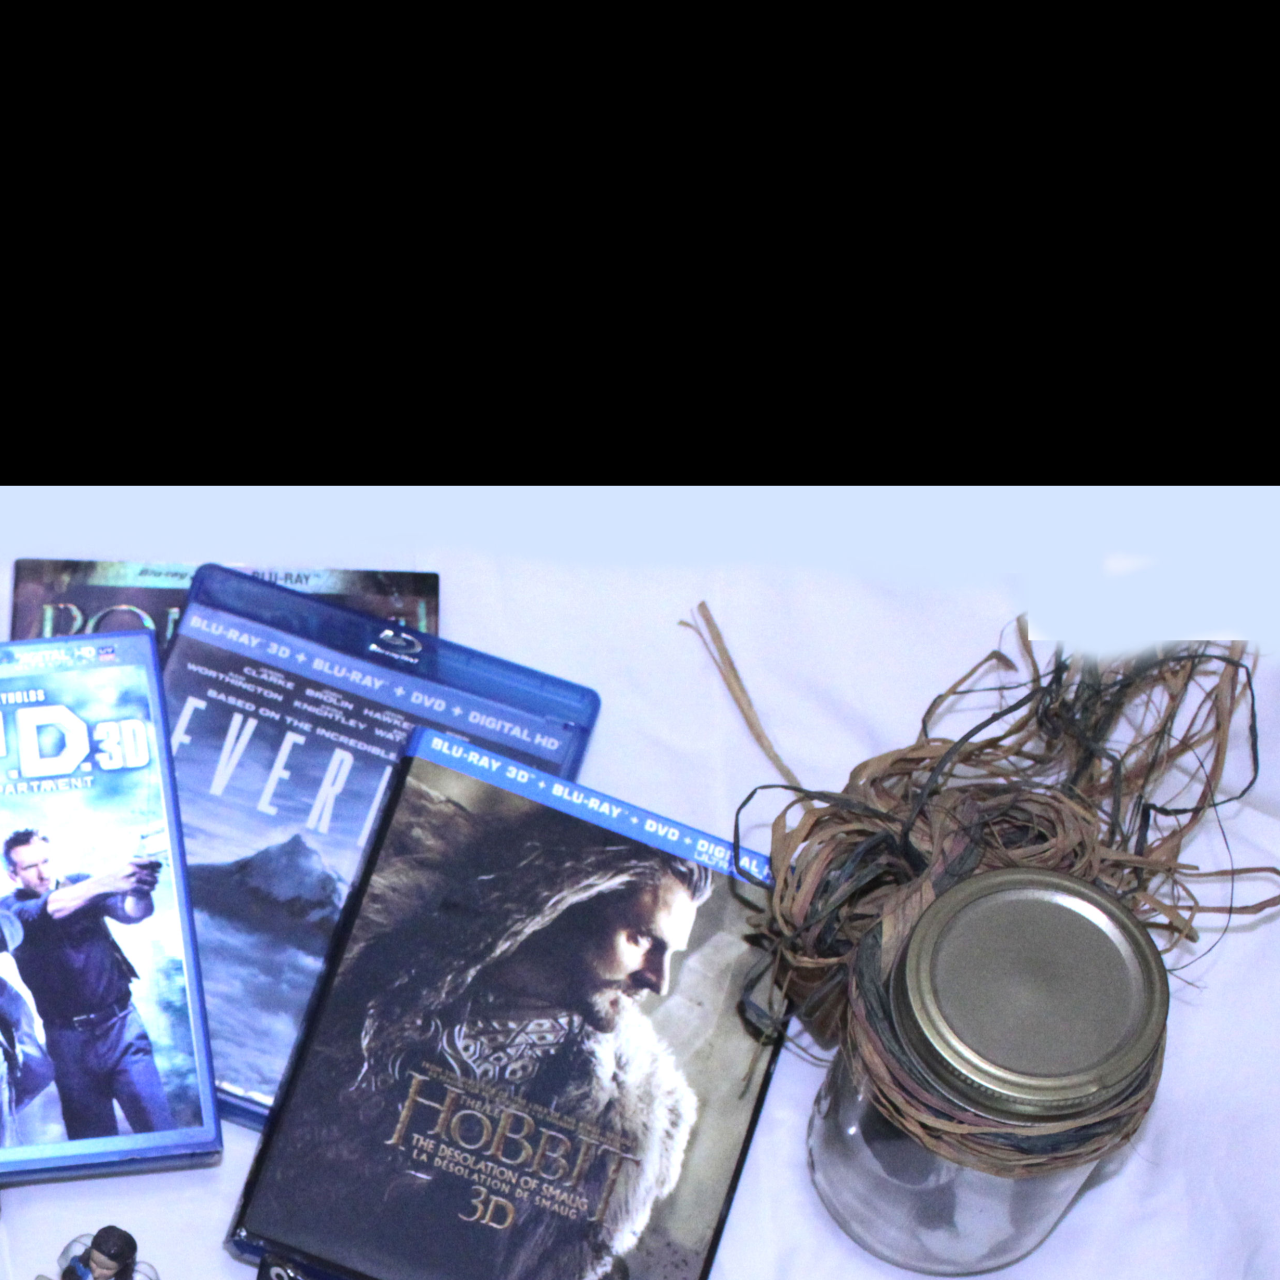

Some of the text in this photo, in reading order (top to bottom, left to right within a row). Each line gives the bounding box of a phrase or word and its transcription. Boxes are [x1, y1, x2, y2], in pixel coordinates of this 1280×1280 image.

[187, 662, 284, 702] WORTHINGTON
[293, 700, 368, 730] KNIGHTLEY
[190, 615, 263, 648] BLU-RAY
[266, 641, 291, 659] 3D
[312, 657, 386, 690] BLU-RAY
[410, 691, 447, 712] DVD
[468, 710, 532, 743] DIGITAL
[534, 734, 561, 751] HD
[243, 666, 296, 691] CLARKE
[305, 688, 354, 711] BROLIN
[93, 719, 150, 771] 3D
[206, 688, 256, 712] BASED
[258, 707, 281, 720] ON
[284, 715, 313, 732] THE
[316, 728, 398, 761] INCREDIBLE
[431, 736, 503, 772] BLU-RAY
[505, 765, 530, 783] 3D
[552, 782, 622, 819] BLU-RAY
[644, 818, 680, 841] DVD
[696, 839, 759, 873] DIGIAL
[384, 1070, 642, 1222] HOBBIT
[412, 1133, 590, 1211] THE DESOLATION OF SMAUG
[412, 1149, 428, 1162] LA
[515, 1188, 530, 1201] DE
[534, 1194, 579, 1220] SMAUG
[457, 1185, 516, 1230] 3D
